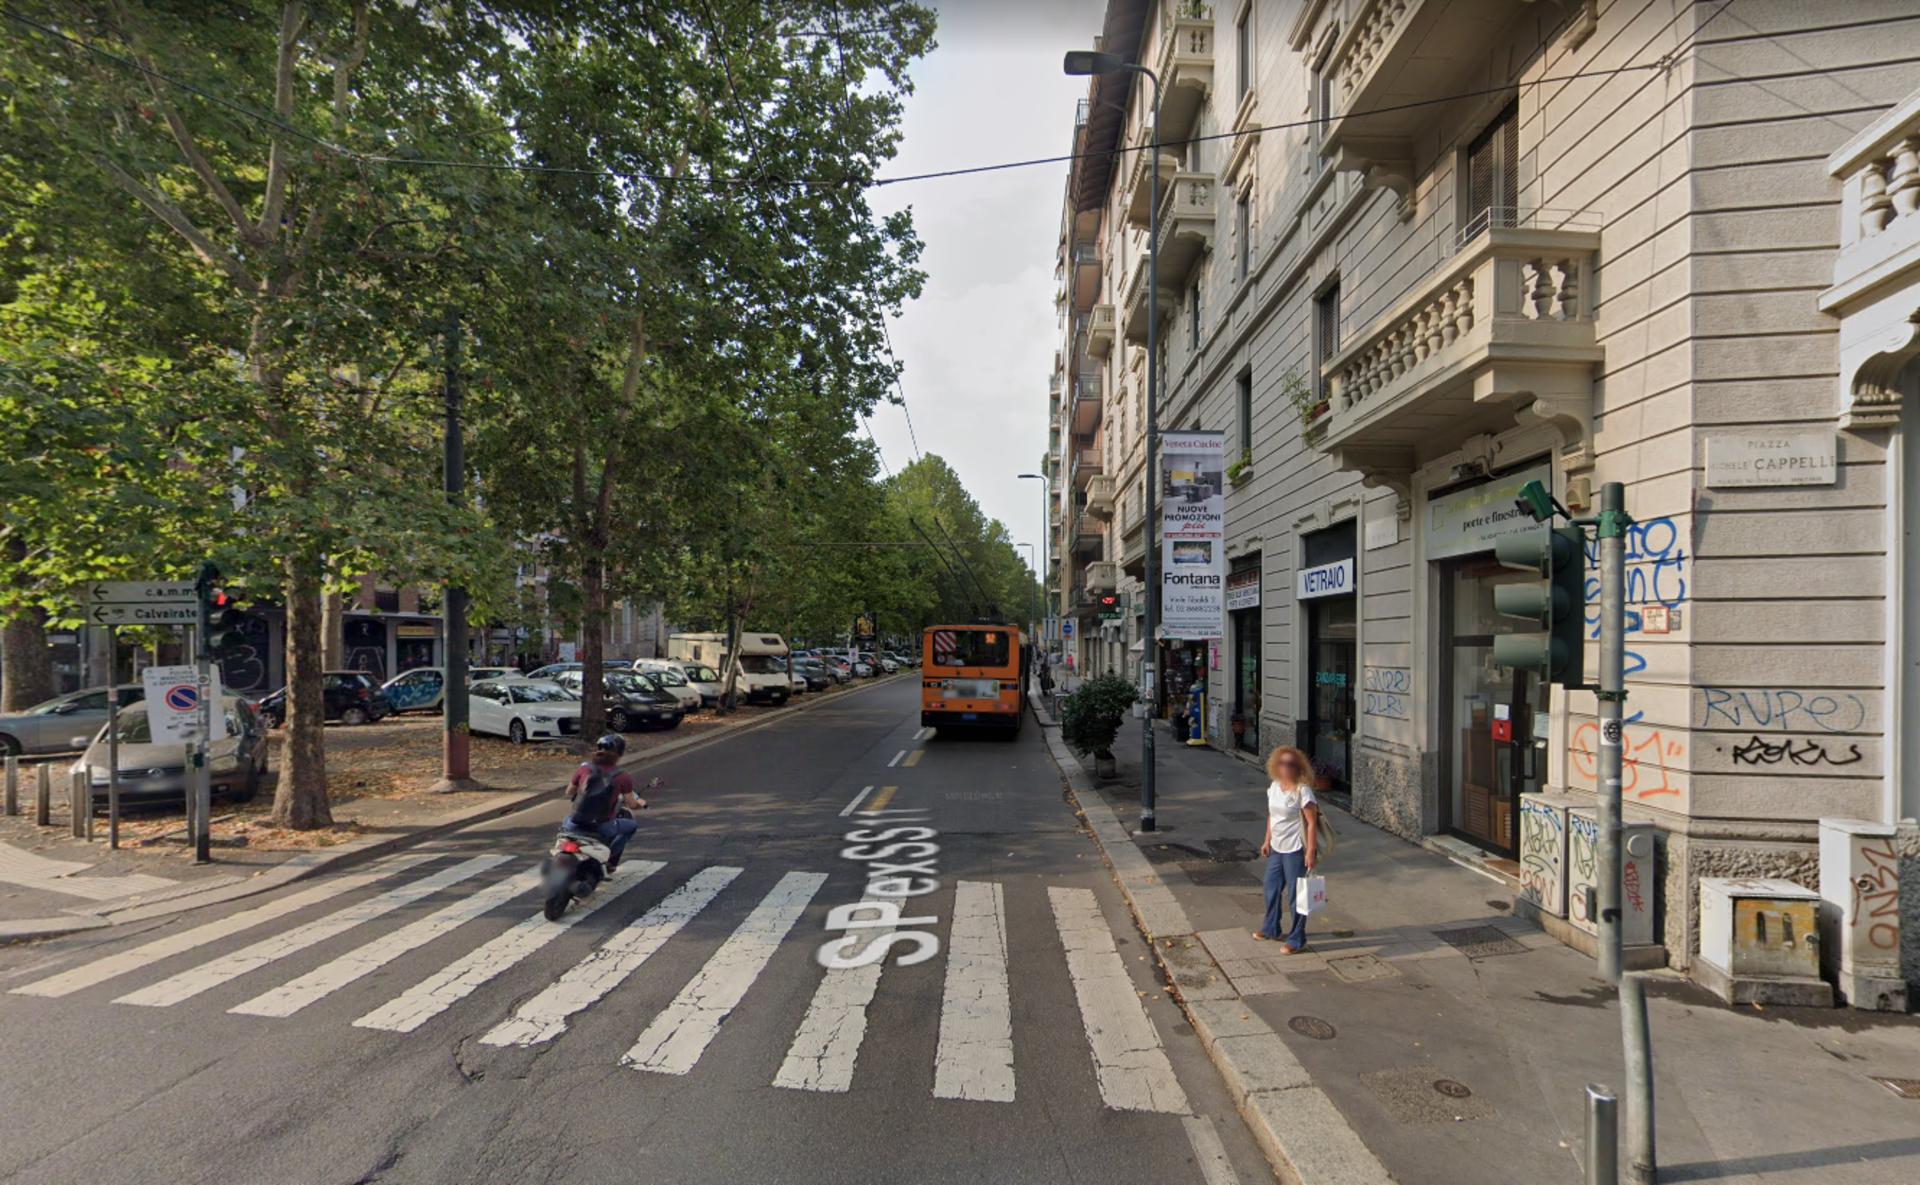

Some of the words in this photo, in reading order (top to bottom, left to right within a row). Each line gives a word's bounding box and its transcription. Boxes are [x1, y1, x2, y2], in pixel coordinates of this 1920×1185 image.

[1747, 440, 1791, 449] PIAZZA
[1754, 455, 1835, 470] CAPPELLI
[1177, 505, 1208, 513] NUOVE
[1164, 513, 1221, 521] PROMOZIONI
[1463, 516, 1483, 531] porte
[1164, 572, 1221, 585] Fontana
[1304, 565, 1345, 593] VETRAIO
[135, 608, 197, 619] Calvairate
